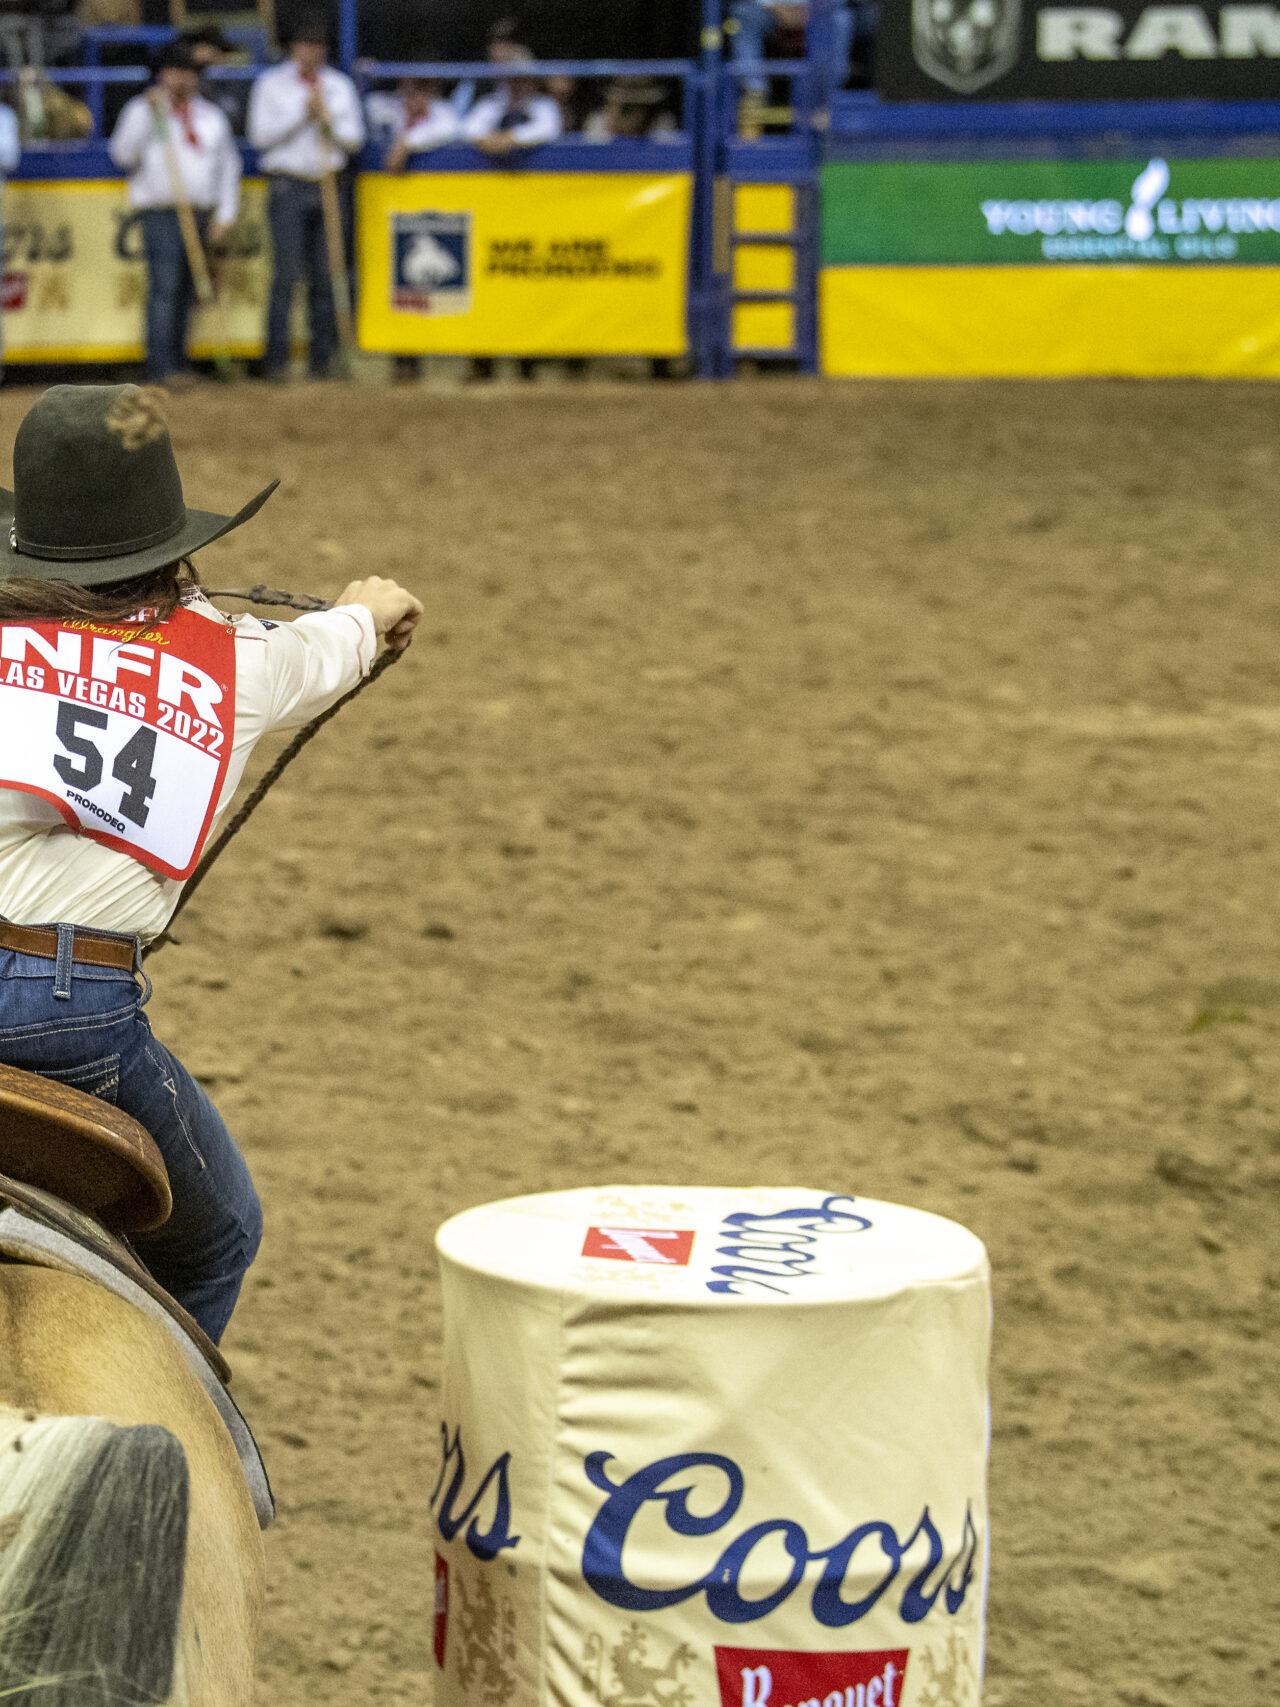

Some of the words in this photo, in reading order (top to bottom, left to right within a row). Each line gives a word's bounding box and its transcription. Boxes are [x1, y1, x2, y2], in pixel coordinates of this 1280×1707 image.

[1036, 6, 1280, 61] RAM
[982, 199, 1122, 234] YOUNG
[0, 626, 223, 729] NFR
[57, 672, 146, 718] VEGAS
[156, 702, 225, 757] 2022
[53, 700, 158, 829] 54
[66, 789, 126, 834] PRORODEO
[582, 1451, 977, 1628] Coors
[740, 1661, 896, 1707] Buet
